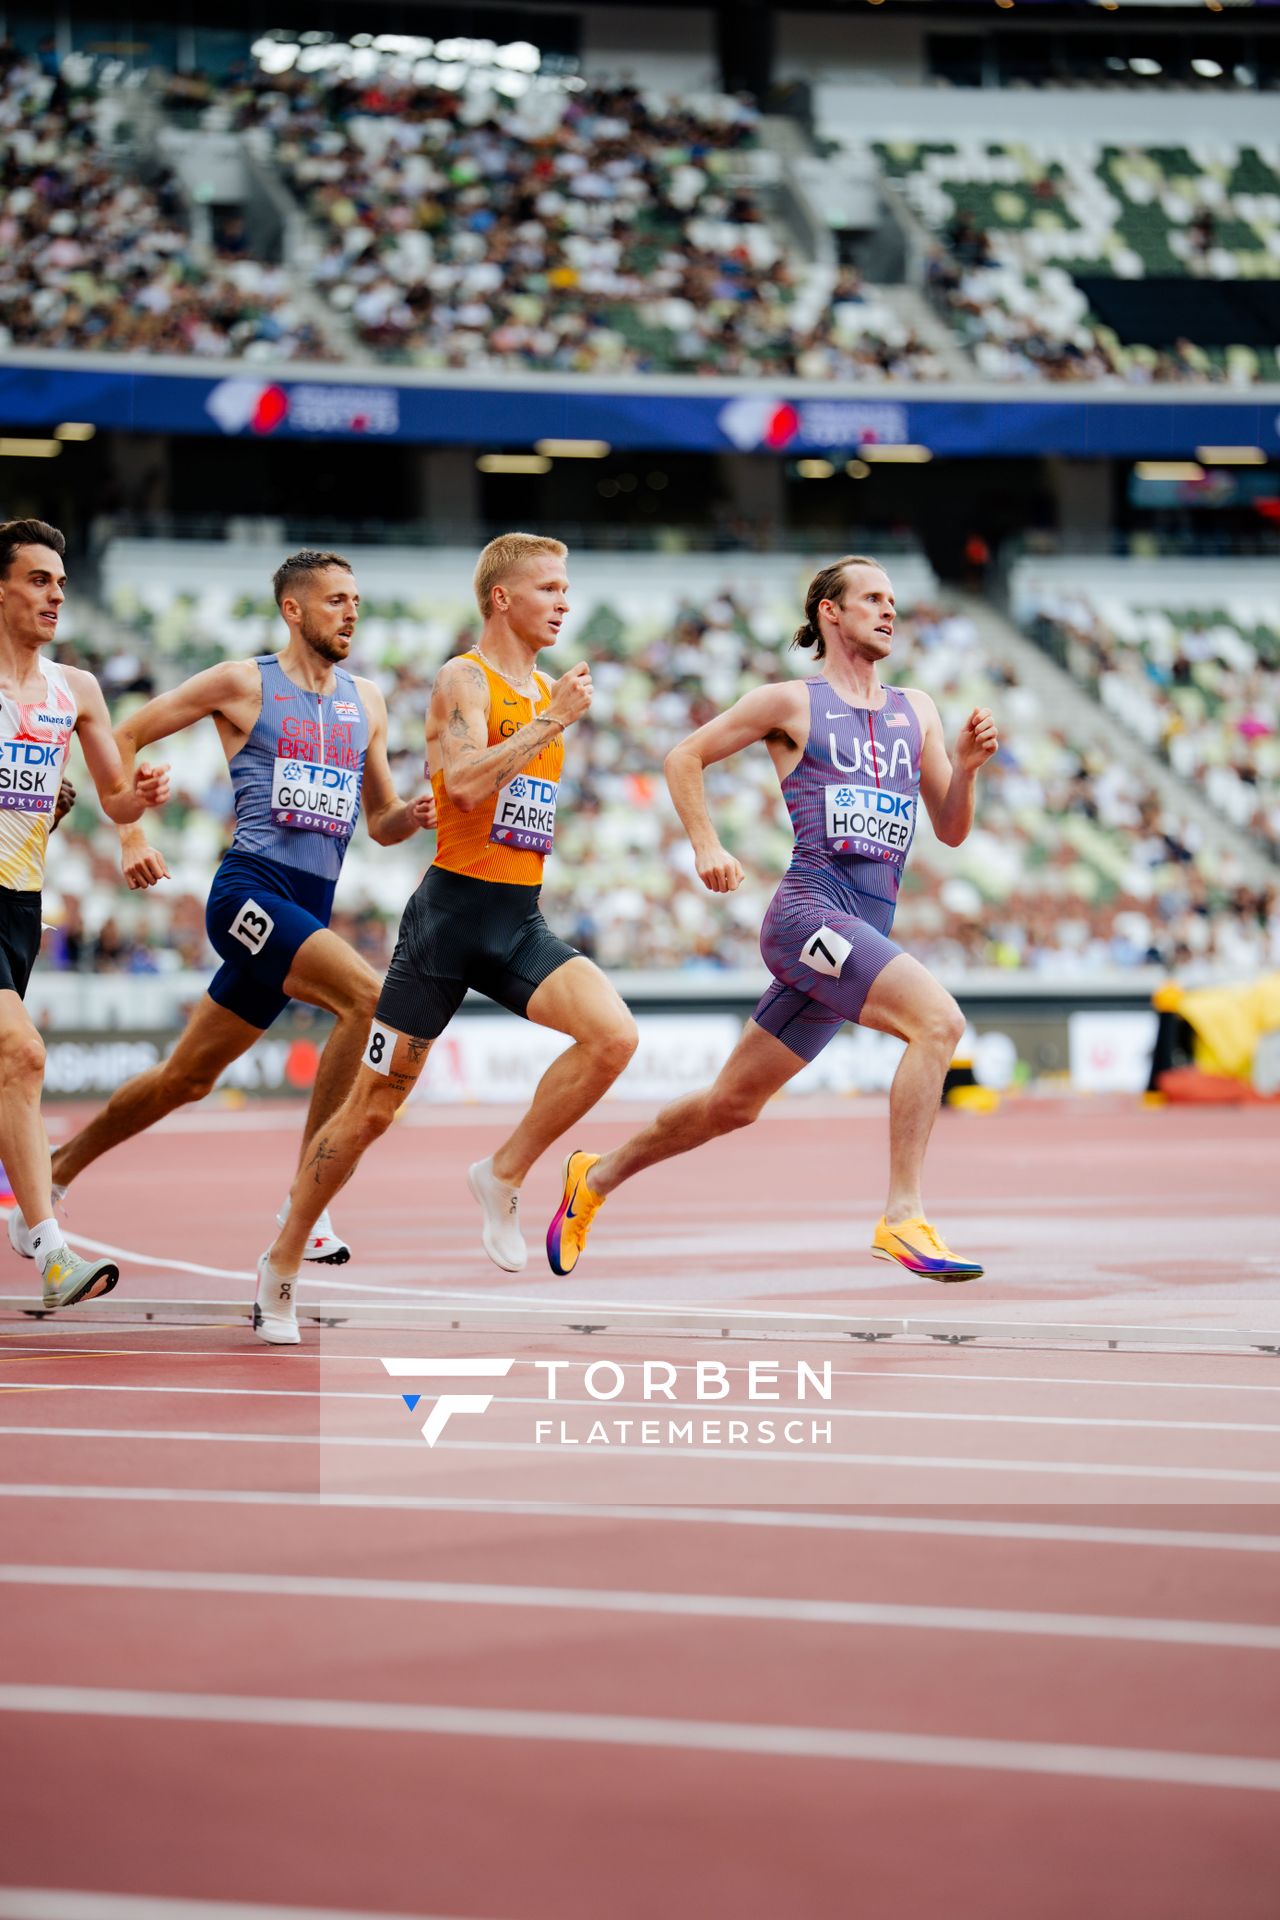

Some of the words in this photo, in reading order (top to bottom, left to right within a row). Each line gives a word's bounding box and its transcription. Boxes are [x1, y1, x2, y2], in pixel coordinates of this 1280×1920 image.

[38, 714, 64, 725] Allianz
[281, 716, 353, 745] GREAT
[4, 742, 61, 767] TDK
[277, 737, 360, 770] BRITAIN
[829, 732, 913, 780] USA
[0, 767, 47, 793] SISK
[303, 764, 353, 793] TDK
[527, 779, 558, 806] TDK
[278, 786, 353, 818] GOURLEY
[855, 788, 913, 821] TDK
[833, 812, 909, 848] HOCKER
[237, 910, 268, 946] 13
[808, 937, 837, 968] 7
[369, 1032, 386, 1064] 8
